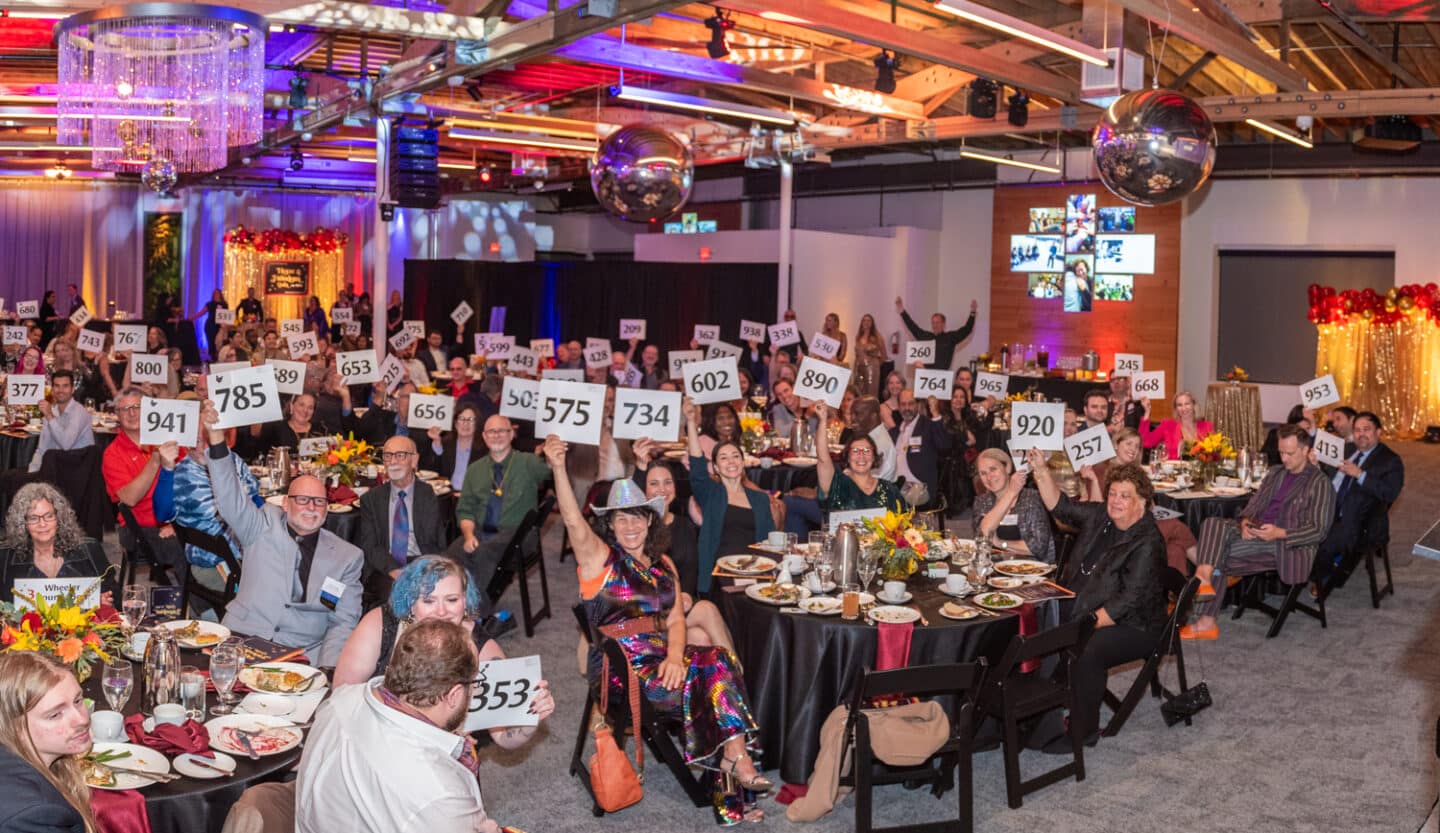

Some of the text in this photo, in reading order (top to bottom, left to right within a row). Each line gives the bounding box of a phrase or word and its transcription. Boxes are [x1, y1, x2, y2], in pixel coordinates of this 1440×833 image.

[284, 324, 300, 333] 545
[744, 326, 761, 337] 938
[773, 328, 793, 341] 338
[82, 335, 100, 347] 743
[292, 338, 314, 353] 593
[395, 333, 409, 347] 692
[910, 346, 931, 358] 260
[135, 362, 162, 375] 800
[341, 360, 371, 376] 653
[513, 354, 534, 368] 443
[1118, 359, 1139, 370] 245
[383, 363, 401, 385] 215
[691, 370, 730, 393] 602
[802, 369, 838, 393] 890
[12, 383, 39, 397] 377
[920, 377, 946, 391] 764
[980, 379, 1002, 392] 965
[1135, 379, 1159, 392] 668
[214, 383, 266, 413] 785
[1305, 384, 1331, 402] 953
[414, 403, 446, 420] 656
[542, 397, 590, 426] 575
[623, 402, 669, 427] 734
[147, 412, 186, 433] 941
[1017, 415, 1055, 436] 920
[1071, 436, 1101, 461] 257
[1316, 440, 1338, 459] 413
[468, 678, 530, 712] 353
